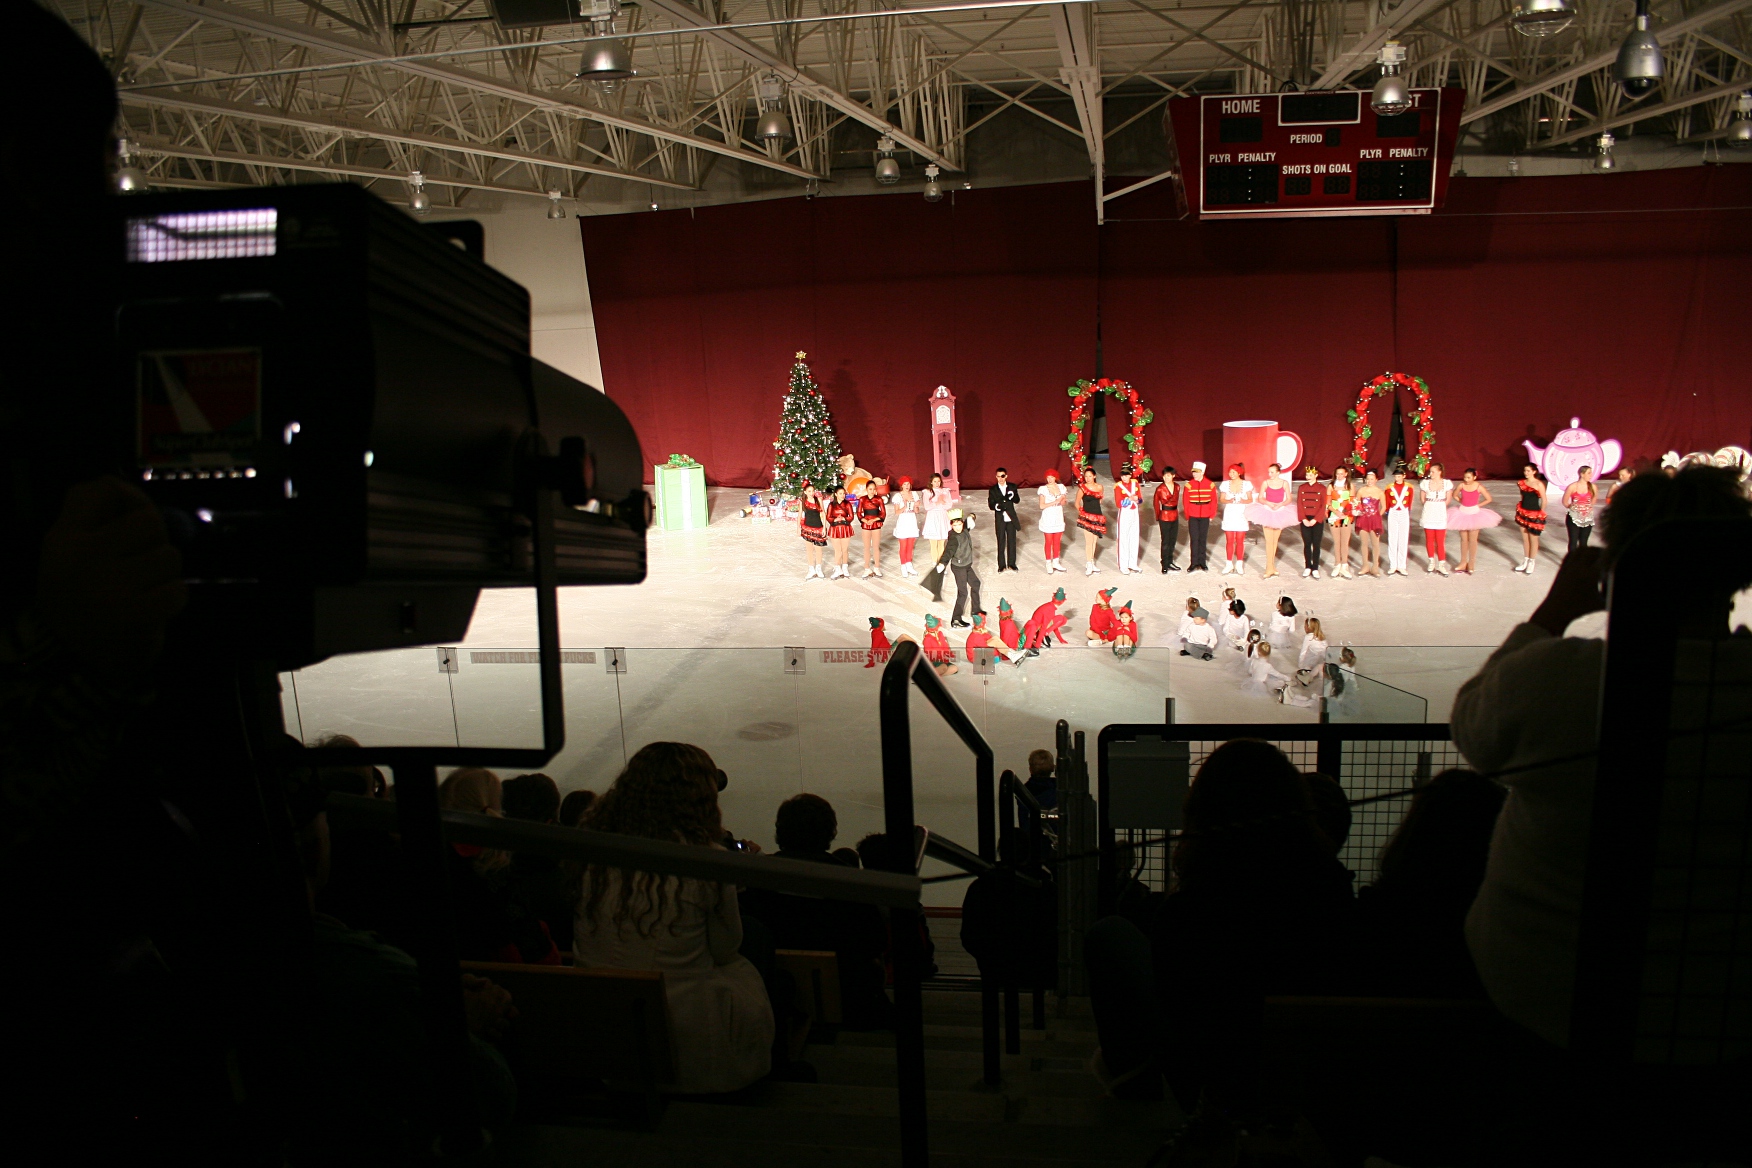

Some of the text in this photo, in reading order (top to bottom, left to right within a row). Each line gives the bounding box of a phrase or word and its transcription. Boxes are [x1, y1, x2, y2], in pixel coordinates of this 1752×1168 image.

[1222, 99, 1261, 114] HOME
[1290, 133, 1323, 144] PERIOD
[1209, 152, 1276, 163] PLYR PENALTY
[1360, 147, 1429, 159] PLYR PENALTY
[1282, 163, 1352, 175] SHOTS ON GOAL
[564, 652, 595, 664] PUCKS
[823, 650, 865, 663] PLEASE
